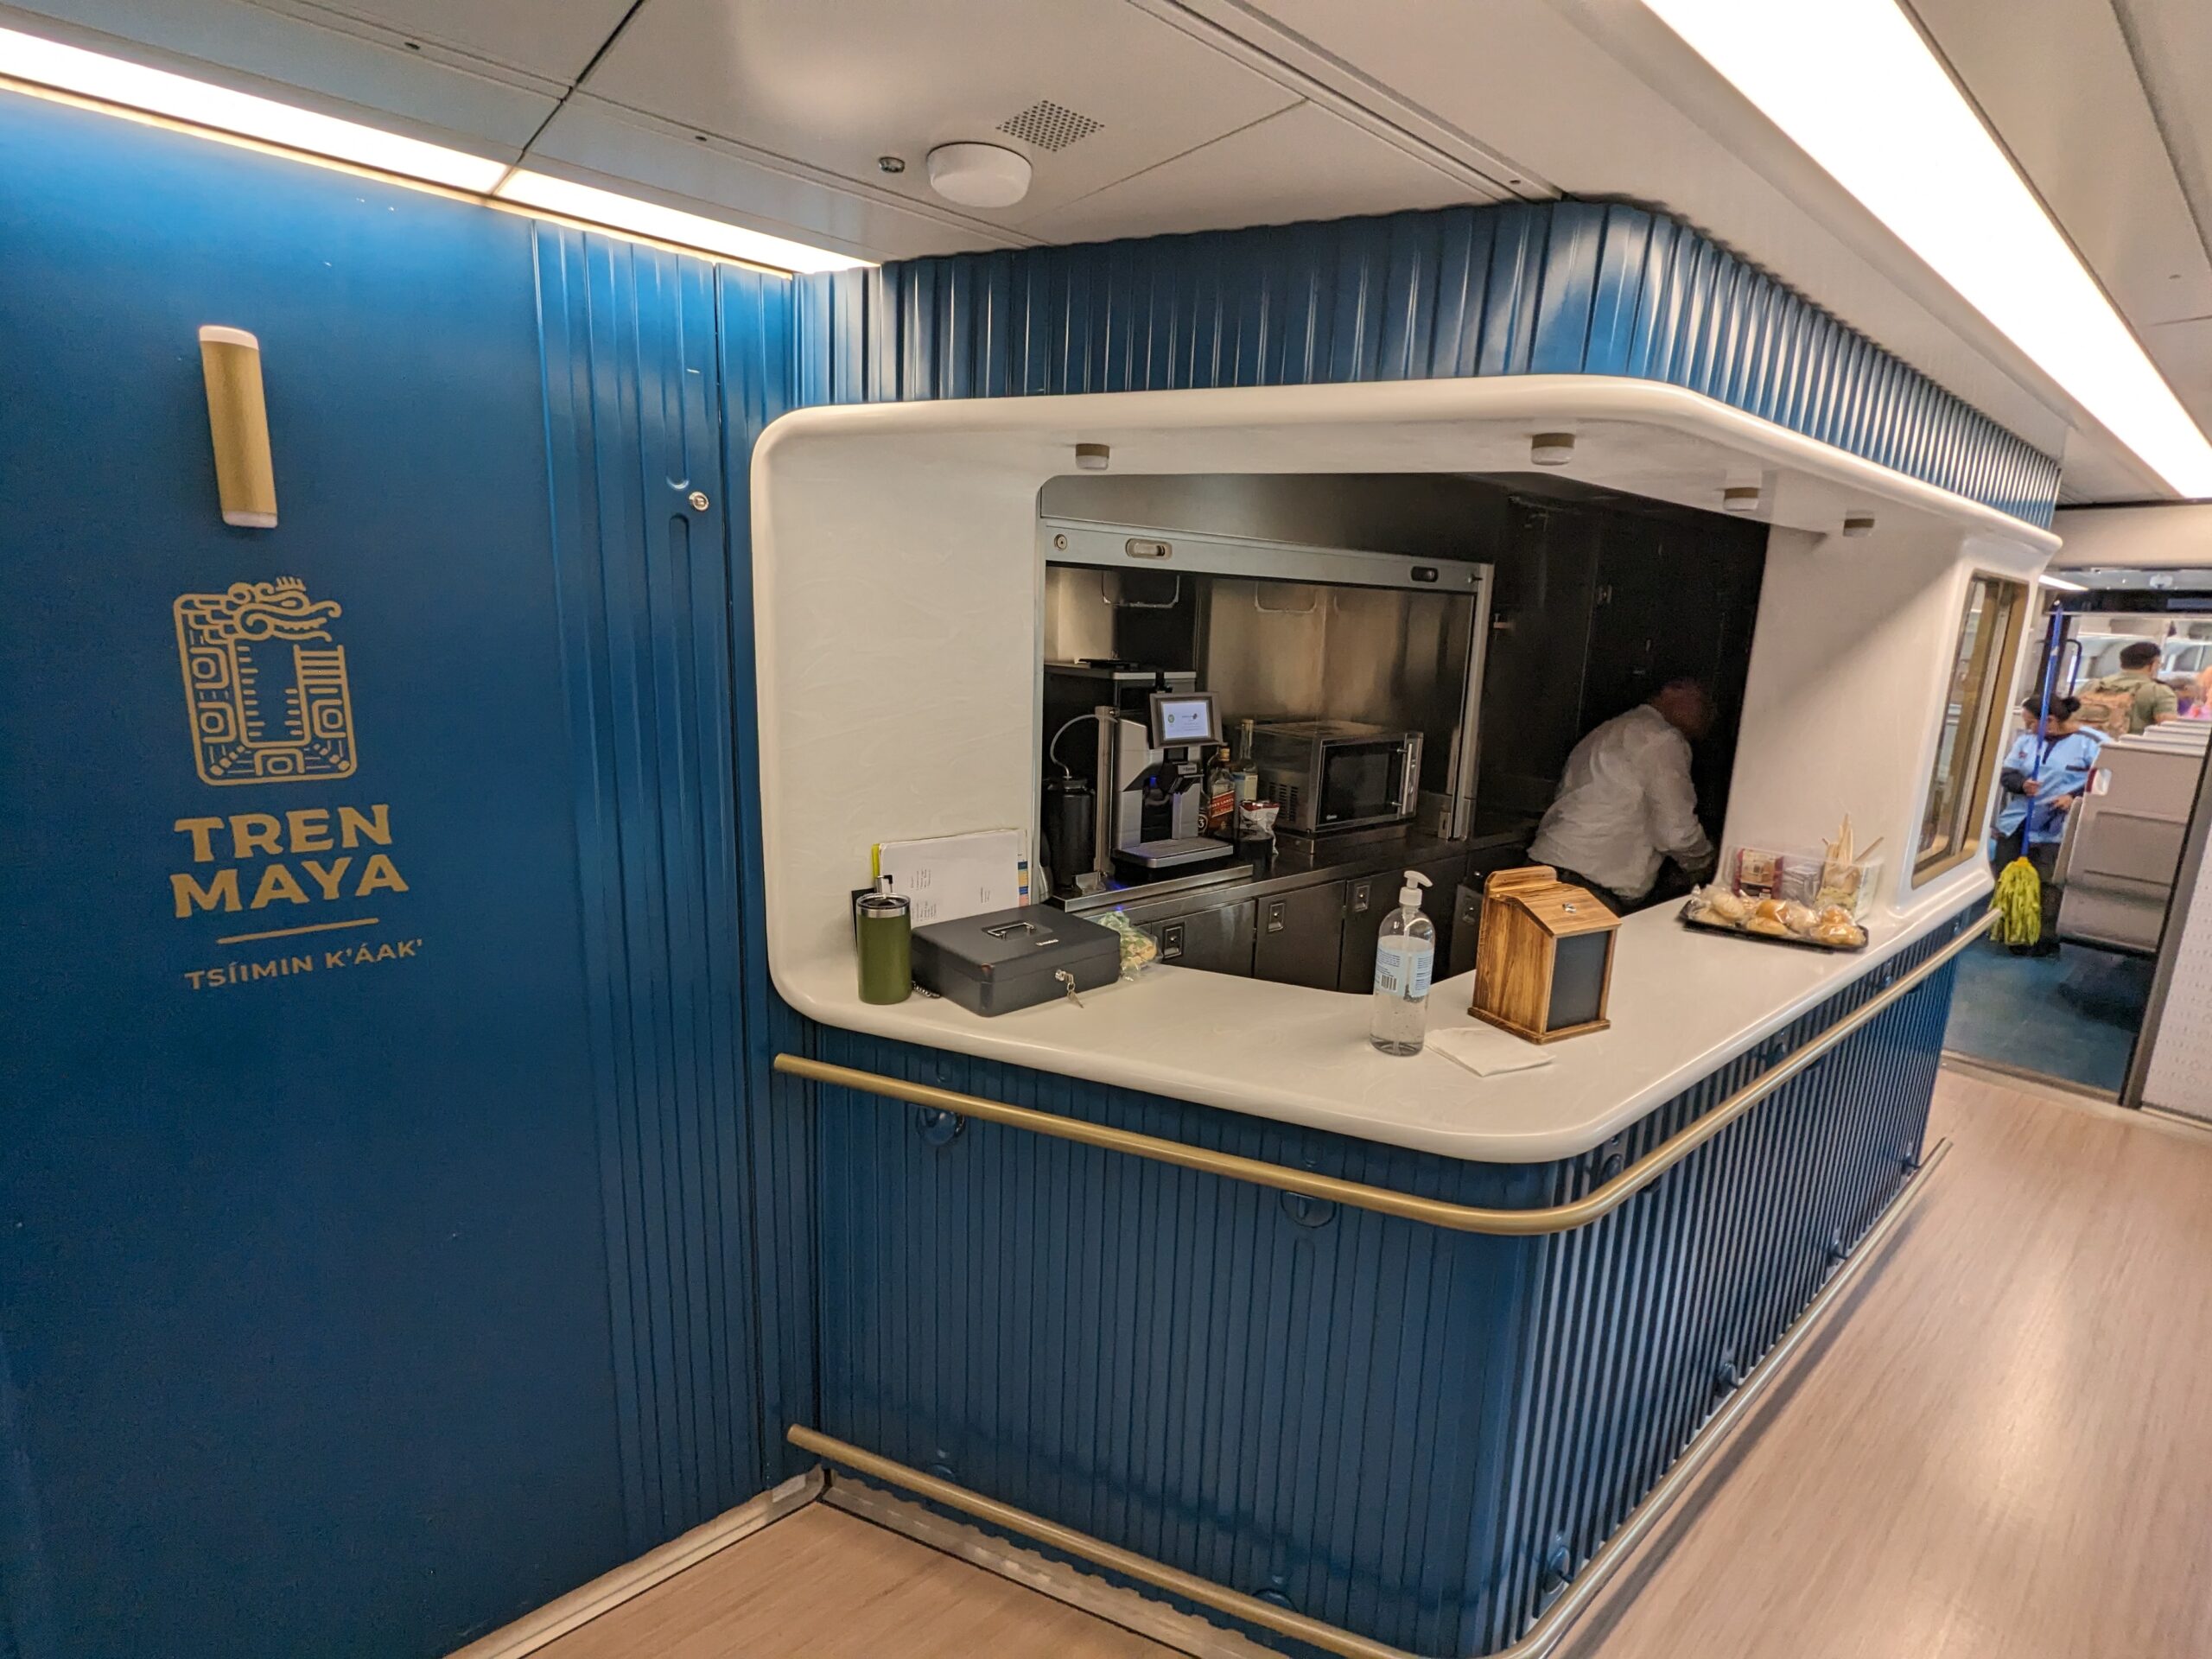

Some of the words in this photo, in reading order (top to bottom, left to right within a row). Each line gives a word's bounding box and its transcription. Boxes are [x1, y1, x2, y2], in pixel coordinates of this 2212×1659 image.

[174, 804, 392, 862] TREN
[169, 854, 410, 918] MAYA
[184, 955, 314, 990] TSÍIMIN
